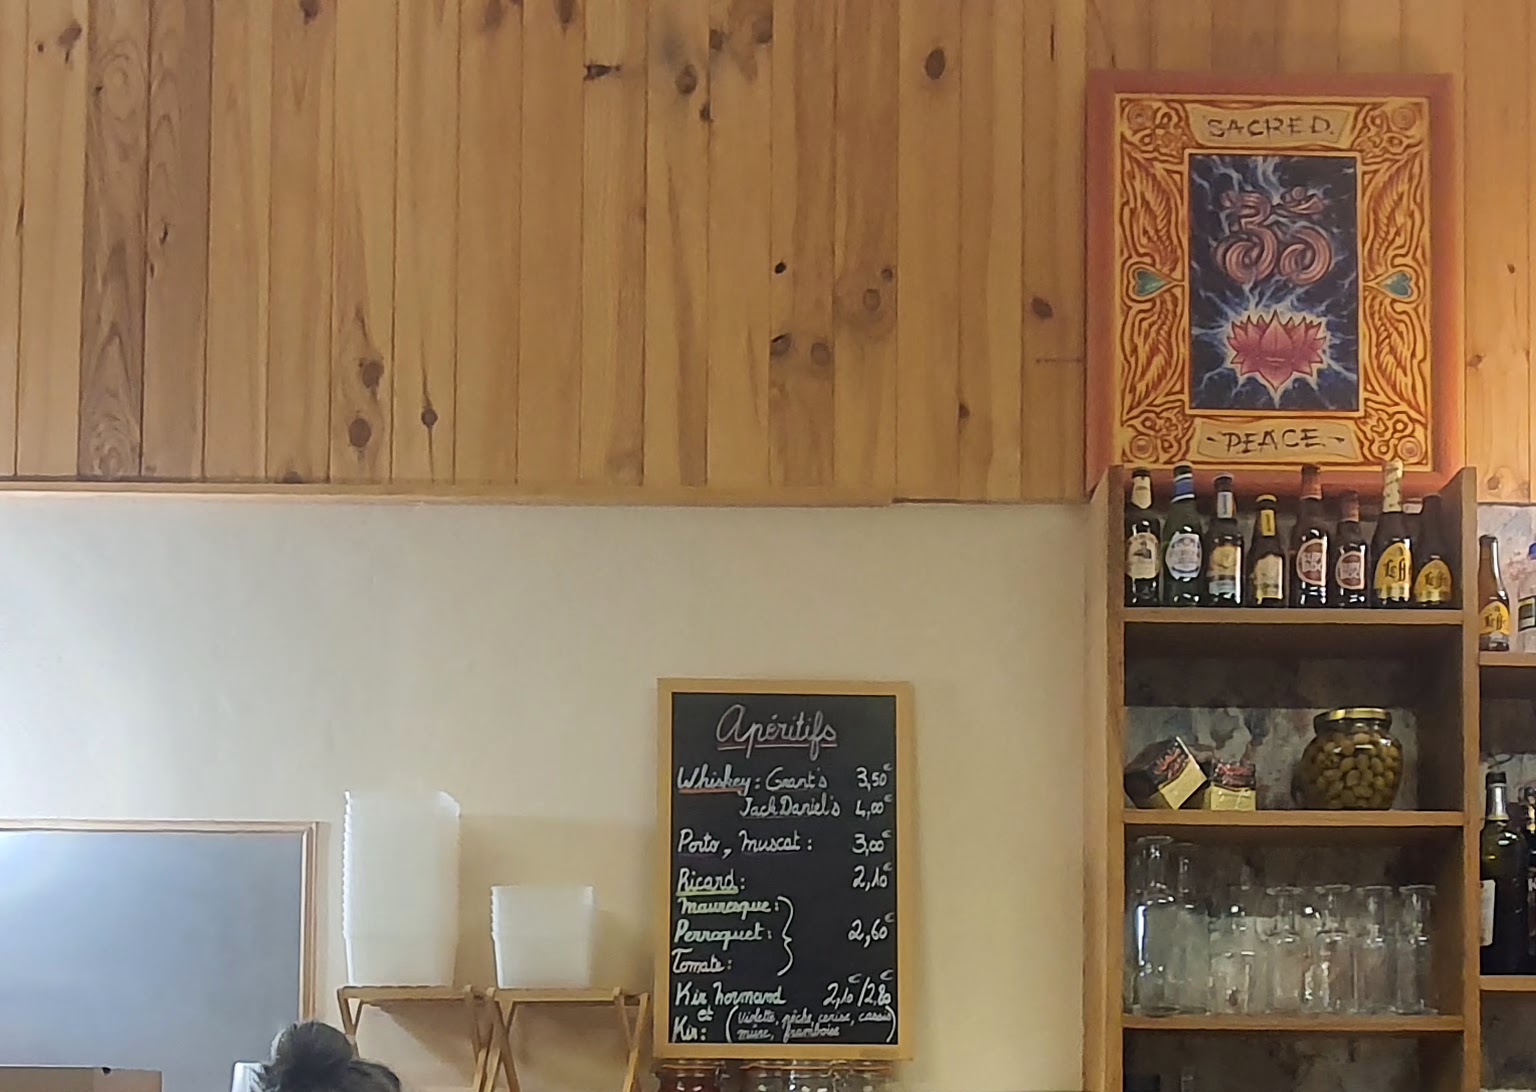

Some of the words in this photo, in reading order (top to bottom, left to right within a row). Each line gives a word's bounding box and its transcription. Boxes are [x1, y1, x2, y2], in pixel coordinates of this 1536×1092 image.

[1383, 557, 1412, 582] Leff
[716, 704, 837, 761] Apéritifs
[765, 766, 828, 791] Grant's
[739, 795, 779, 818] Jack
[779, 793, 841, 817] Daniel's
[697, 1005, 714, 1022] et
